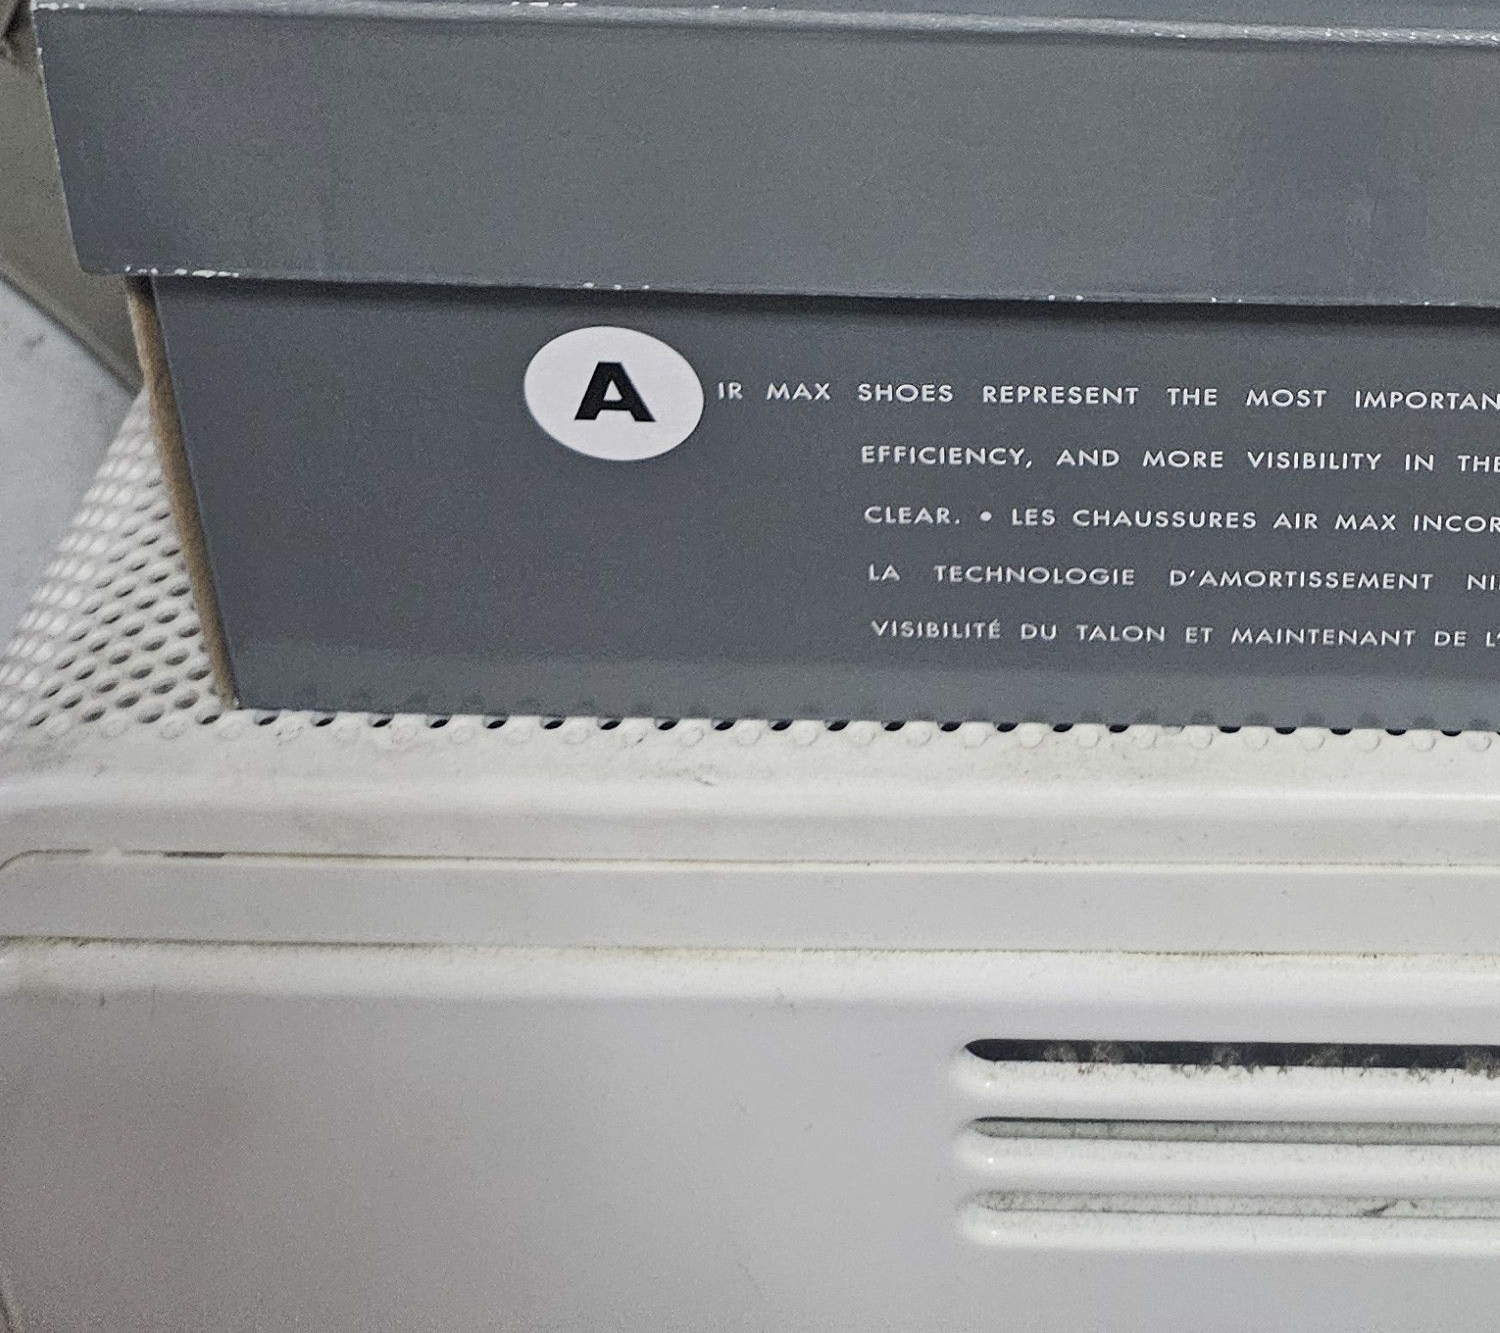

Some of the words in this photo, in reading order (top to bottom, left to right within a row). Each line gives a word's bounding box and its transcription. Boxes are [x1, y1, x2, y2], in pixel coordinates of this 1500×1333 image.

[574, 361, 655, 423] A
[718, 382, 743, 400] IR
[766, 382, 831, 401] MAX
[858, 383, 954, 403] SHOES
[982, 385, 1139, 405] REPRESENT
[1166, 387, 1218, 407] THE
[1245, 389, 1327, 408] MOST
[861, 445, 1033, 469] EFFICIENCY,
[1056, 449, 1120, 467] AND
[1142, 450, 1224, 469] MORE
[1247, 451, 1382, 471] VISIBILITY
[1405, 453, 1434, 471] IN
[864, 505, 960, 525] CLEAR.
[1011, 508, 1056, 526] LES
[1072, 509, 1257, 529] CHAUSSURES
[1273, 512, 1318, 530] AIR
[1334, 514, 1396, 531] MAX
[868, 564, 900, 581] LA
[933, 565, 1135, 586] TECHNOLOGIE
[871, 618, 1001, 639] VISIBILITÉ
[1020, 623, 1057, 641] DU
[1076, 624, 1165, 642] TALON
[1185, 626, 1213, 644] ET
[1231, 628, 1416, 646] MAINTENANT
[1434, 630, 1467, 647] DE
